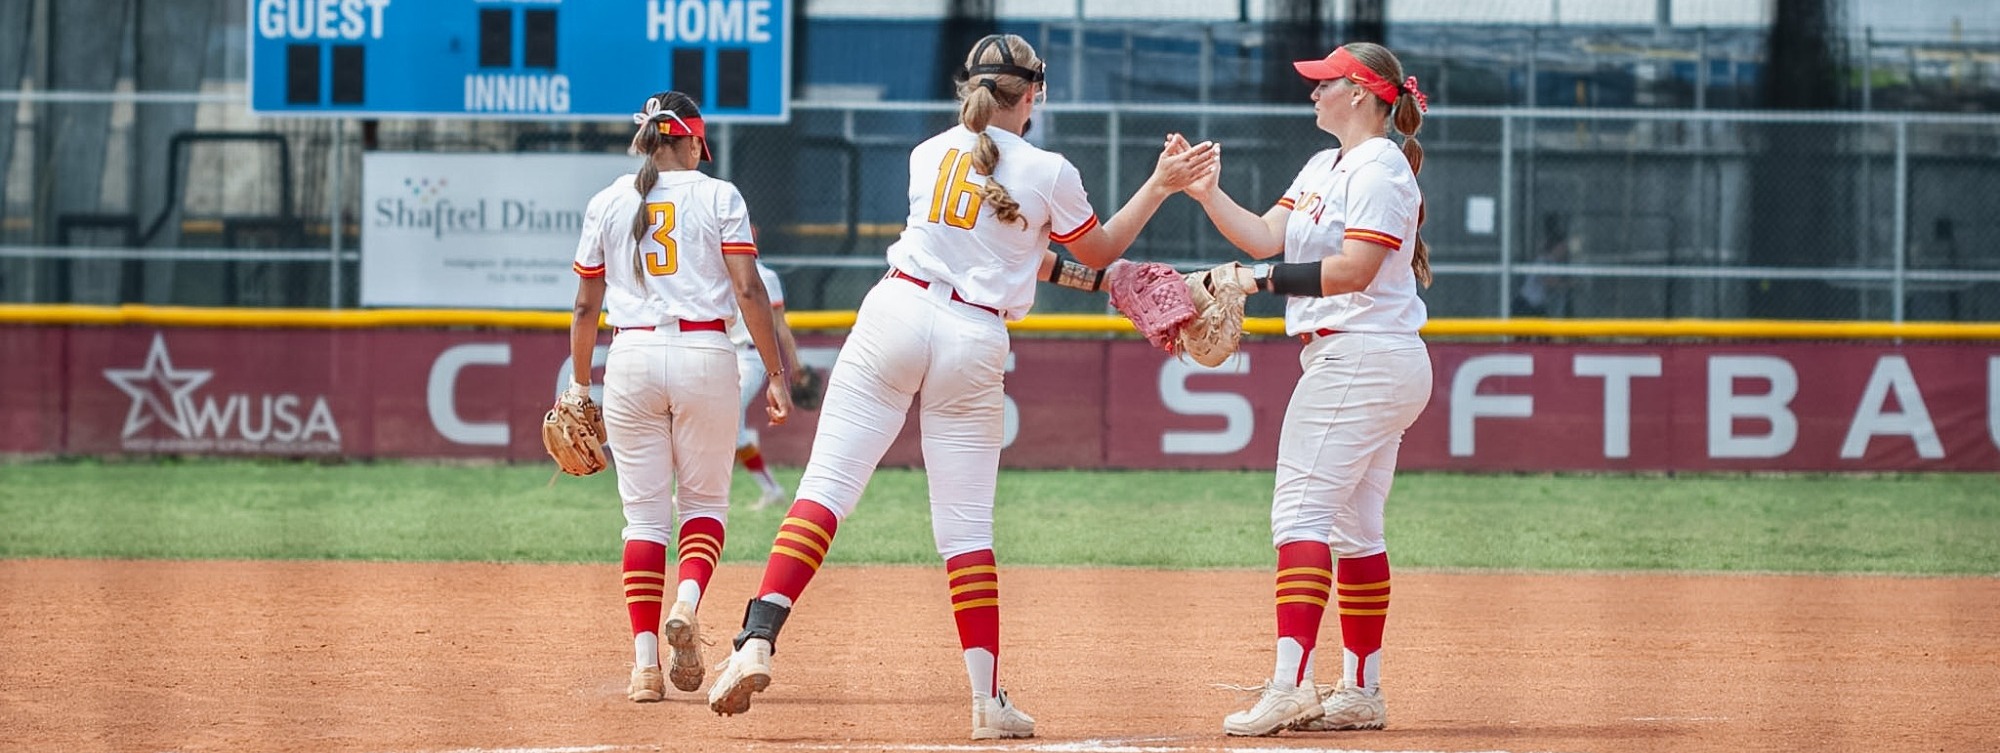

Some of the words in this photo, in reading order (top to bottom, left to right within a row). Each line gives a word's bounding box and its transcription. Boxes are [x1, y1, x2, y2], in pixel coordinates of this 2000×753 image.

[258, 0, 391, 39] GUEST
[646, 0, 772, 42] HOME
[464, 74, 571, 112] INNING
[928, 148, 984, 231] 16
[375, 197, 488, 240] Shaftel
[645, 201, 678, 277] 3
[182, 394, 341, 442] WUSA
